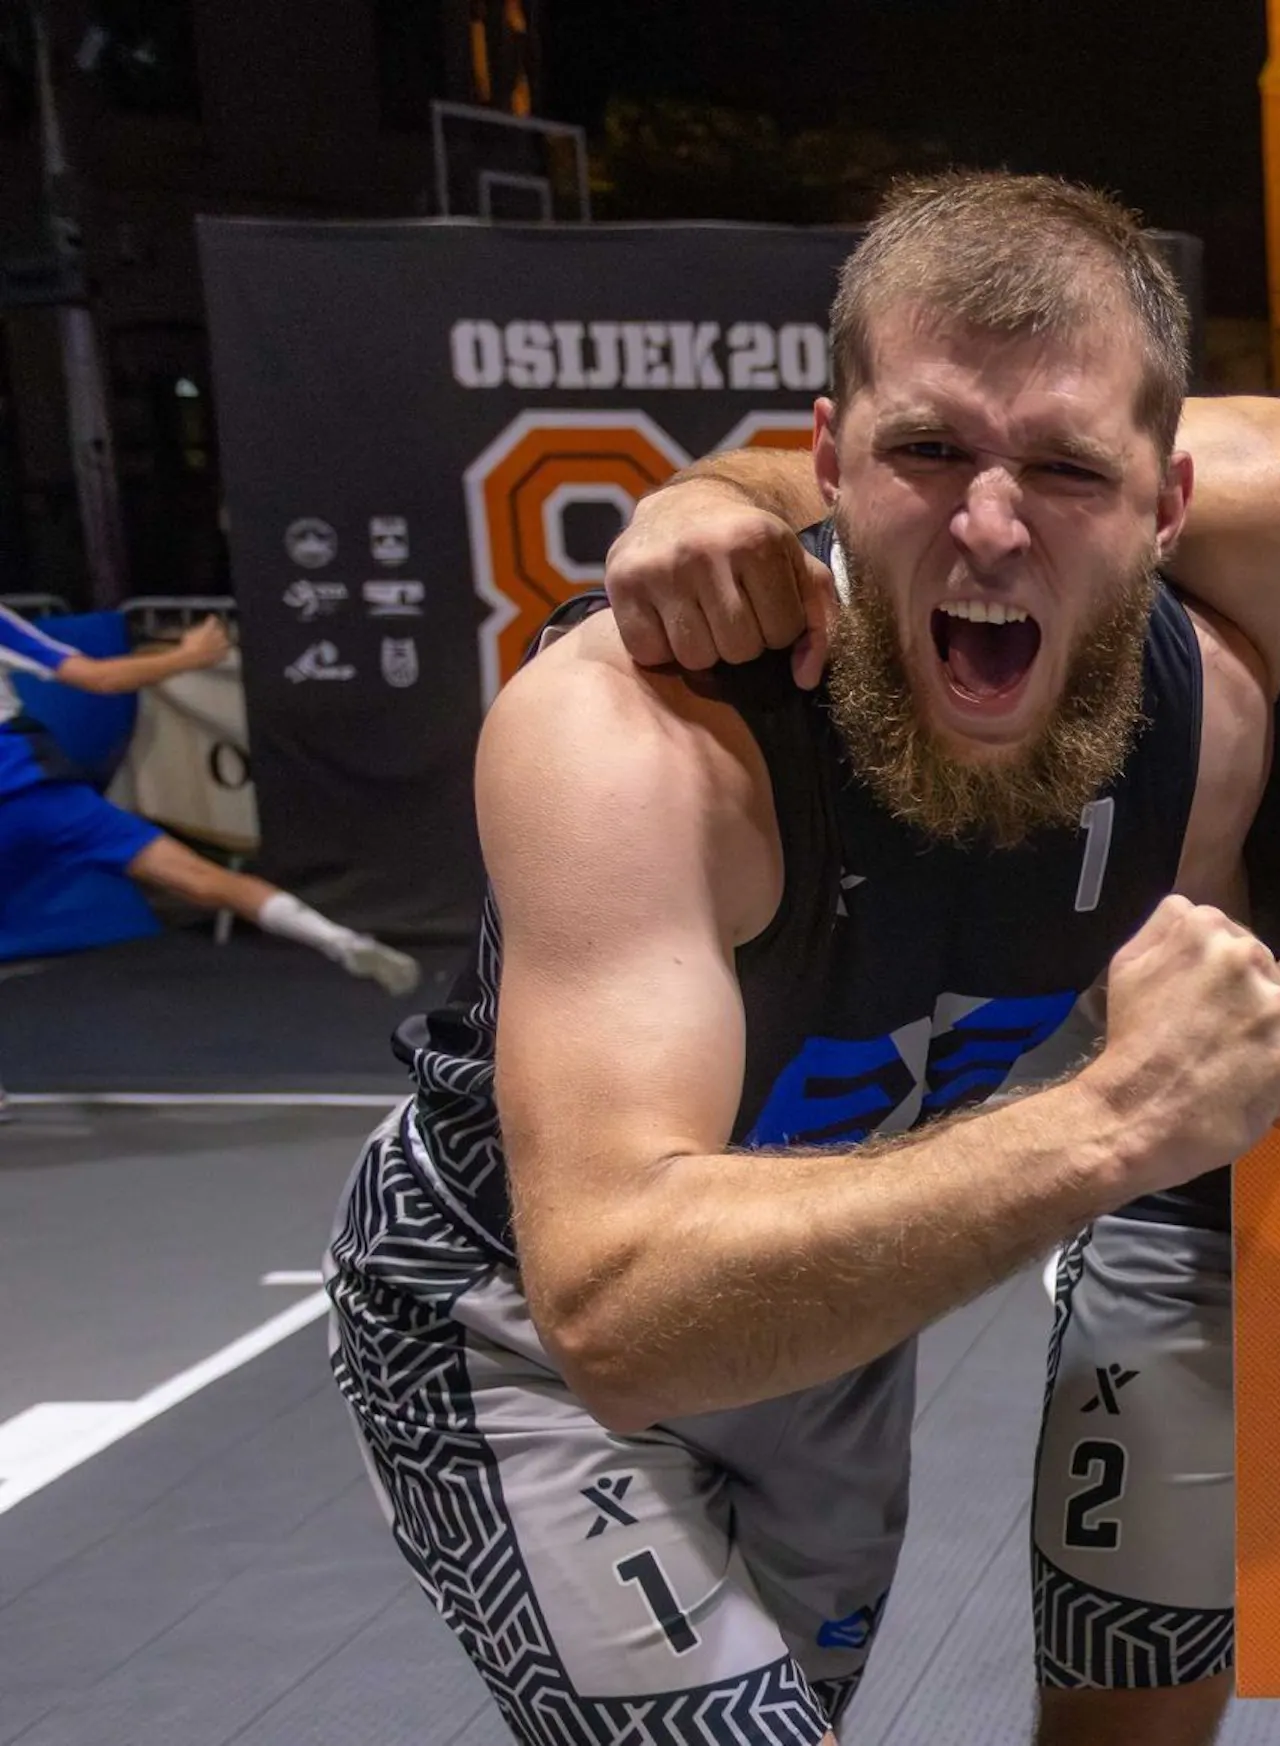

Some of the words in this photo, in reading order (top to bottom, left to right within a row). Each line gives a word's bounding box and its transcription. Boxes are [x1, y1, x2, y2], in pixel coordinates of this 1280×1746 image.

[450, 318, 724, 390] OSIJEK
[1074, 796, 1115, 912] 1
[1063, 1437, 1128, 1551] 2
[615, 1545, 702, 1656] 1
